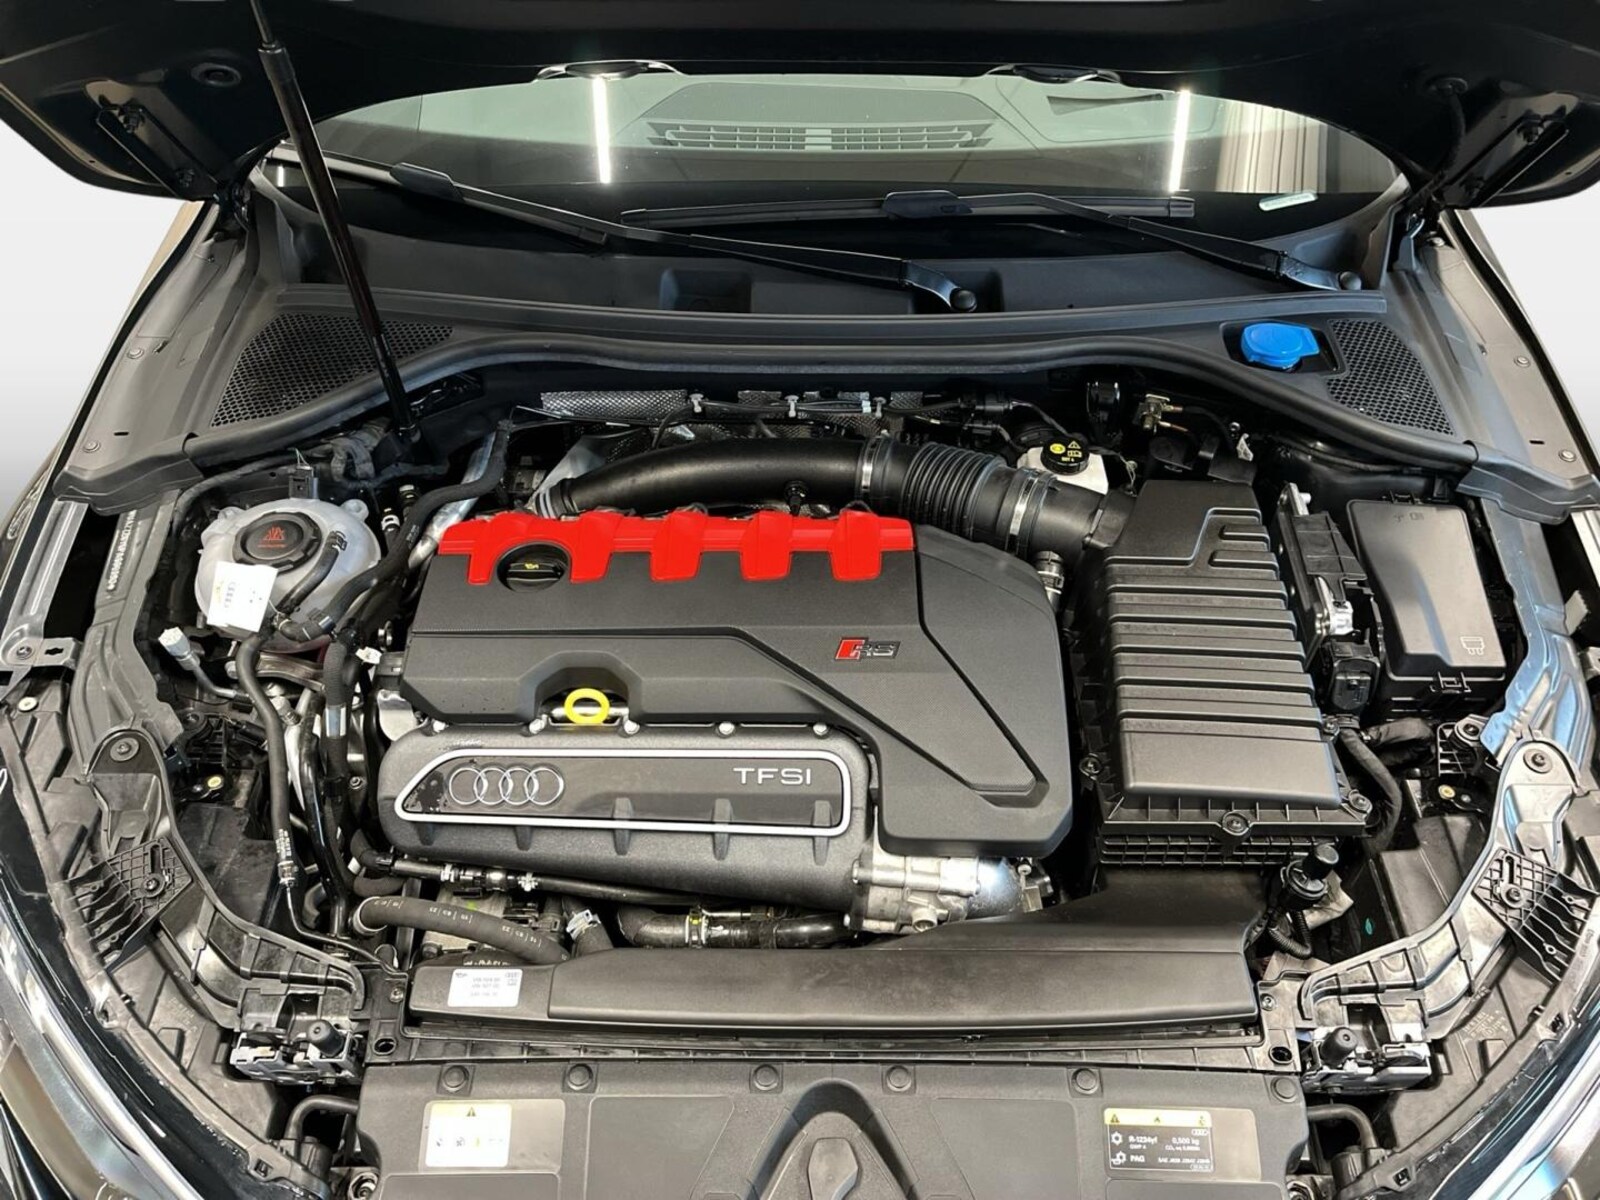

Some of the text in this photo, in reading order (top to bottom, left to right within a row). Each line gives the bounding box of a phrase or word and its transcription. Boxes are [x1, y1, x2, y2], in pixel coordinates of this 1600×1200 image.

[836, 637, 900, 661] RS
[733, 767, 812, 786] TFSI
[1130, 1155, 1146, 1163] PAG
